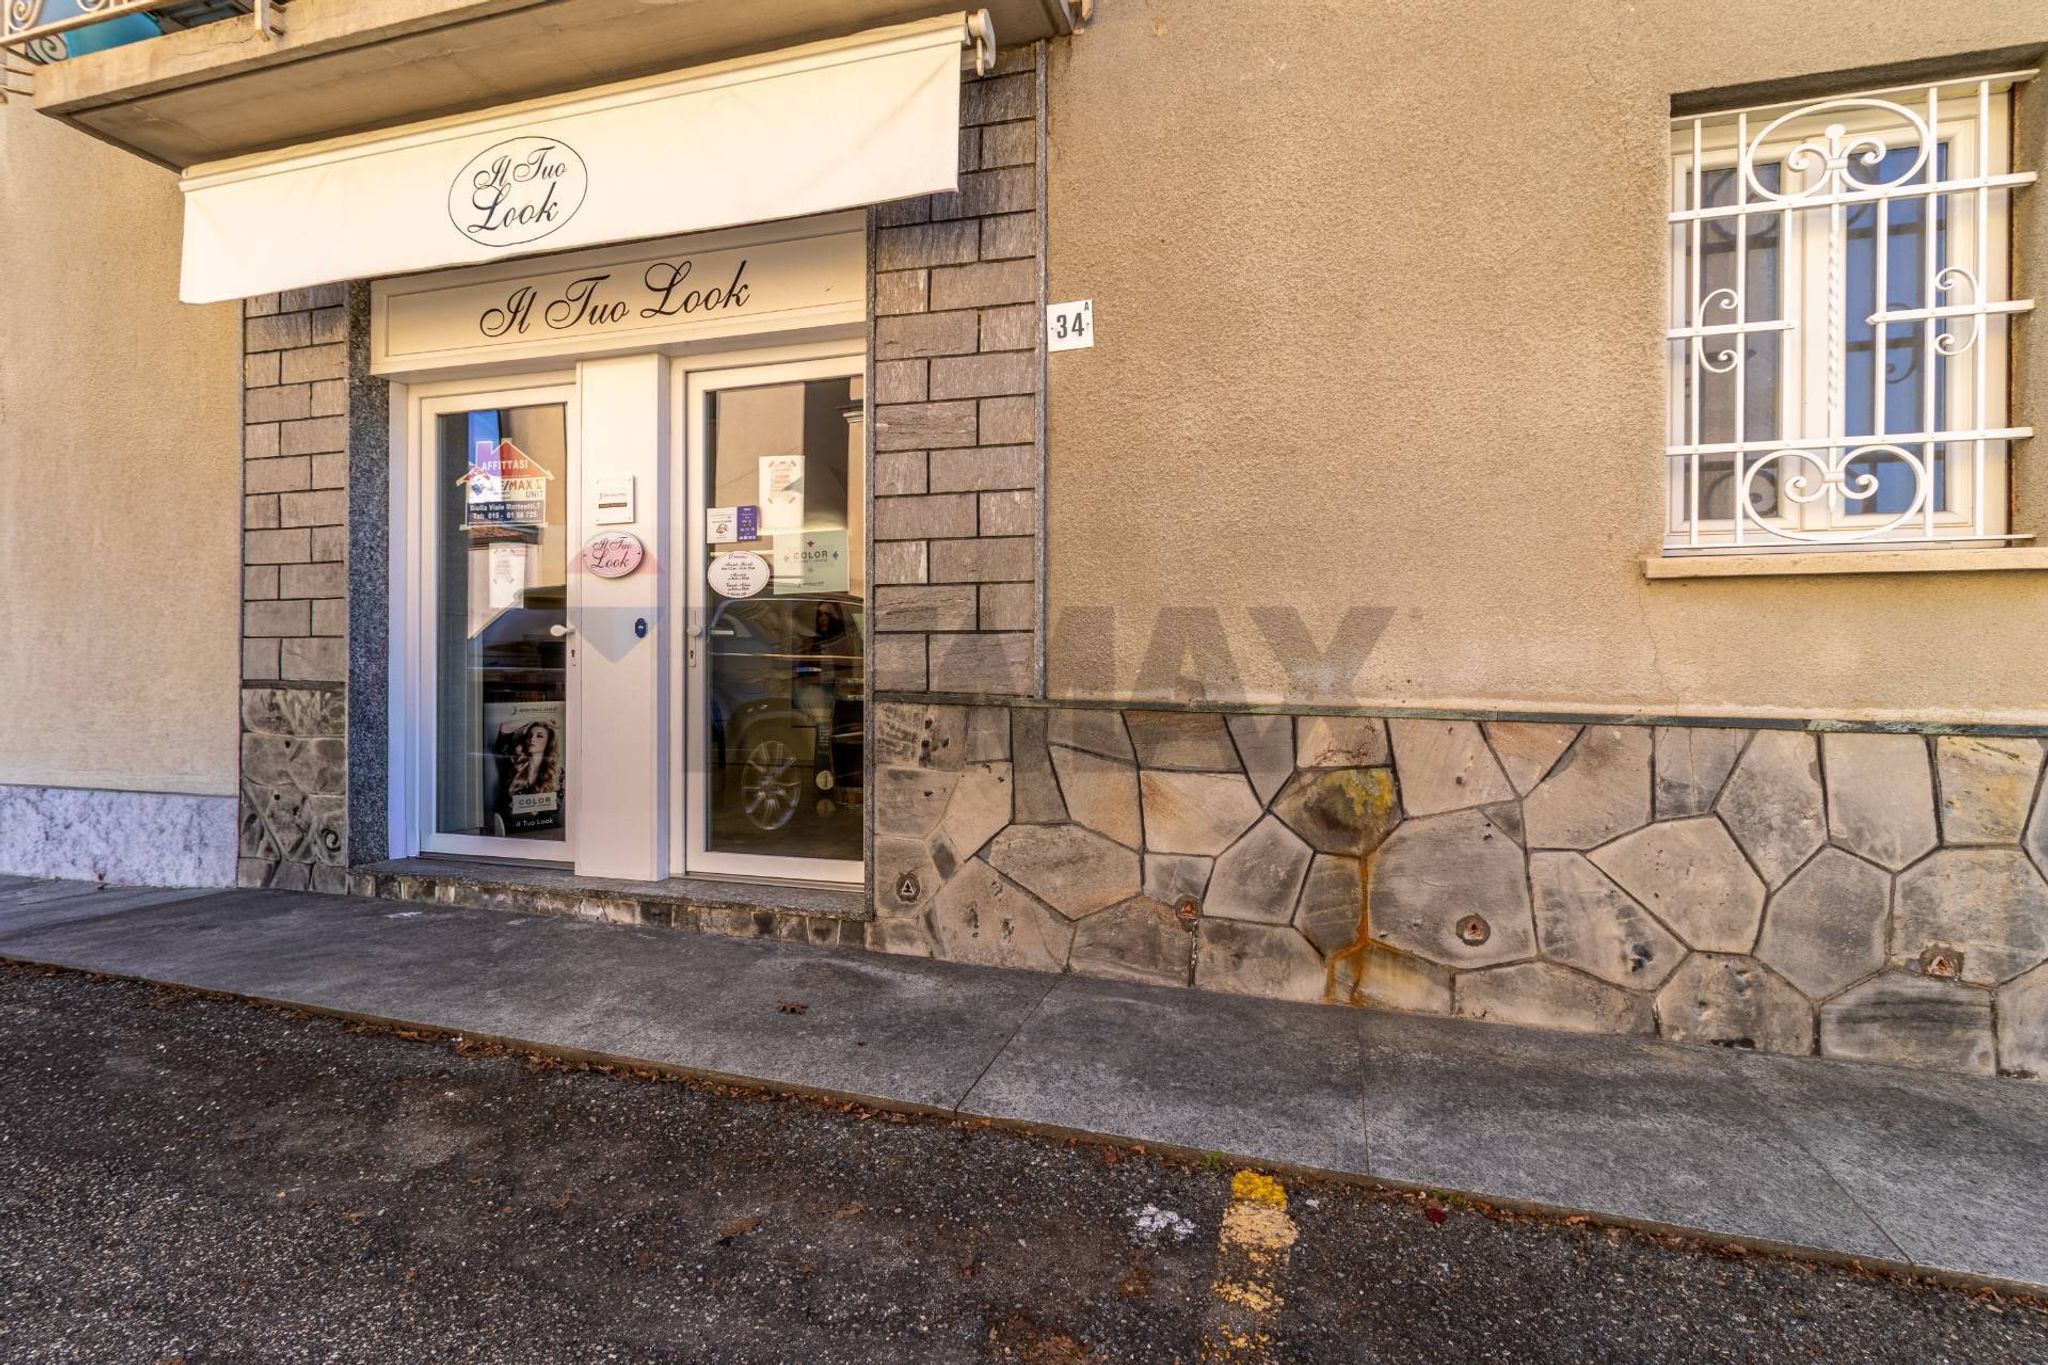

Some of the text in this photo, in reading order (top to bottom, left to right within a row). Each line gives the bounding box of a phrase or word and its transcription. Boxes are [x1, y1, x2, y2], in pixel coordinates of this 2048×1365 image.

[473, 145, 567, 188] Il Tuo
[467, 181, 560, 233] Look
[480, 260, 751, 338] Il Tuo Look
[1056, 312, 1085, 339] 34
[482, 460, 528, 471] AFFITTASI
[609, 536, 631, 551] Tuo
[591, 550, 629, 568] Look
[793, 550, 828, 561] COLOR
[519, 796, 551, 806] COLOR
[536, 816, 554, 825] Look
